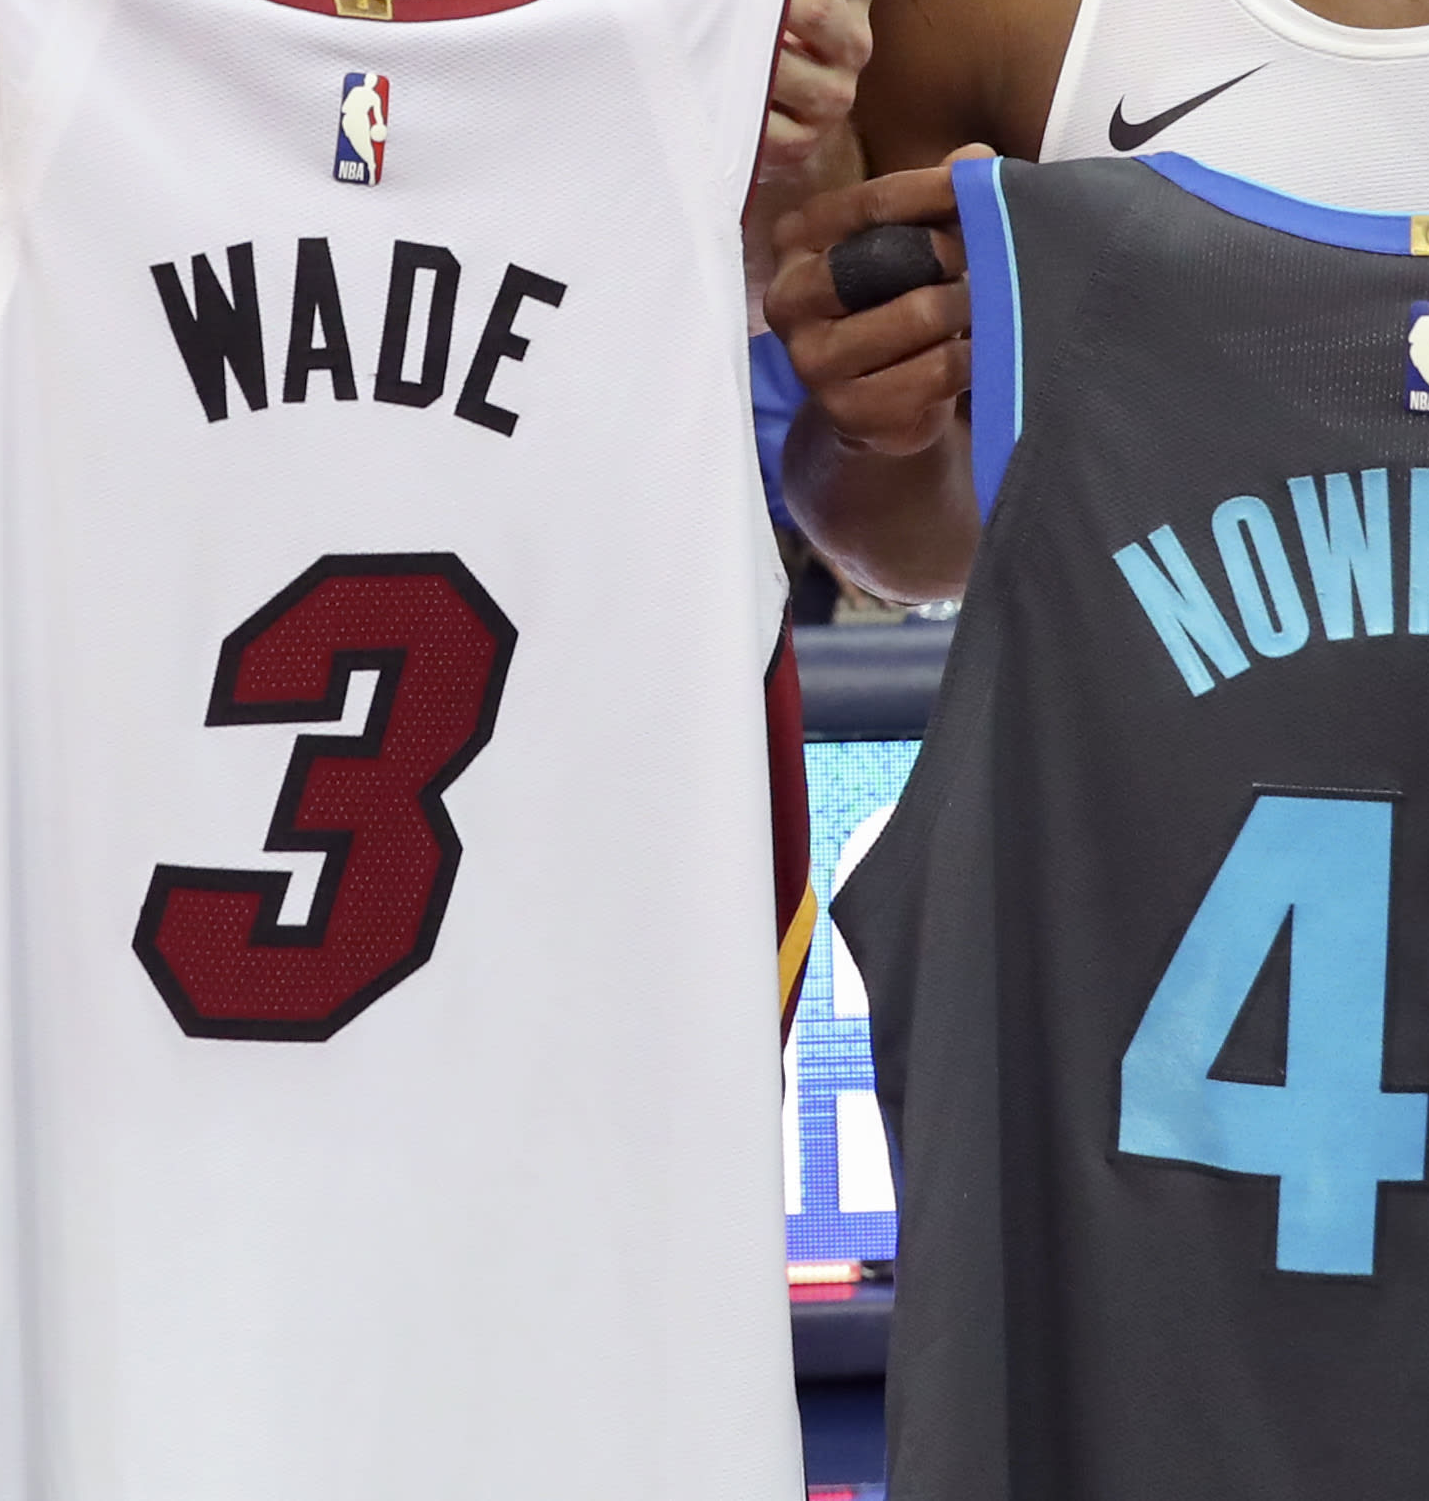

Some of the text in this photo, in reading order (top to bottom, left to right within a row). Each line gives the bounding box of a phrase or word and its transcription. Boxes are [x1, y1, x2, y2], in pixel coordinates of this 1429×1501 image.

[338, 159, 365, 182] NBA
[149, 236, 569, 438] WADE
[131, 551, 520, 1043] 3
